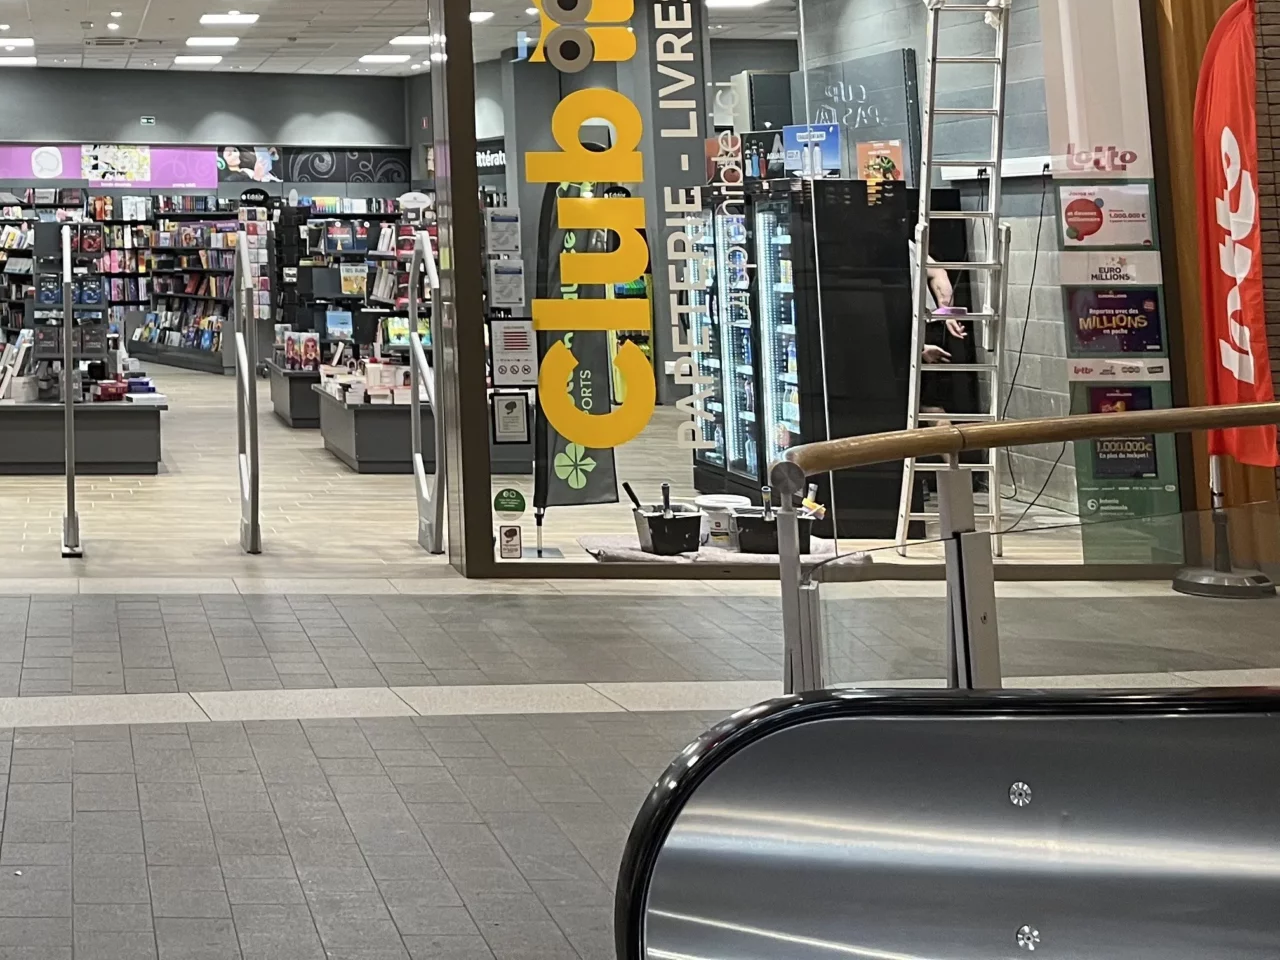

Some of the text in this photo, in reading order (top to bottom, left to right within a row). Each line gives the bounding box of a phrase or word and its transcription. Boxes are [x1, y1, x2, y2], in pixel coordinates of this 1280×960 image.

[525, 88, 656, 449] Club
[664, 184, 721, 450] PAPETERIE
[1078, 314, 1148, 330] MILLIONS
[1091, 273, 1130, 281] MILLIONS
